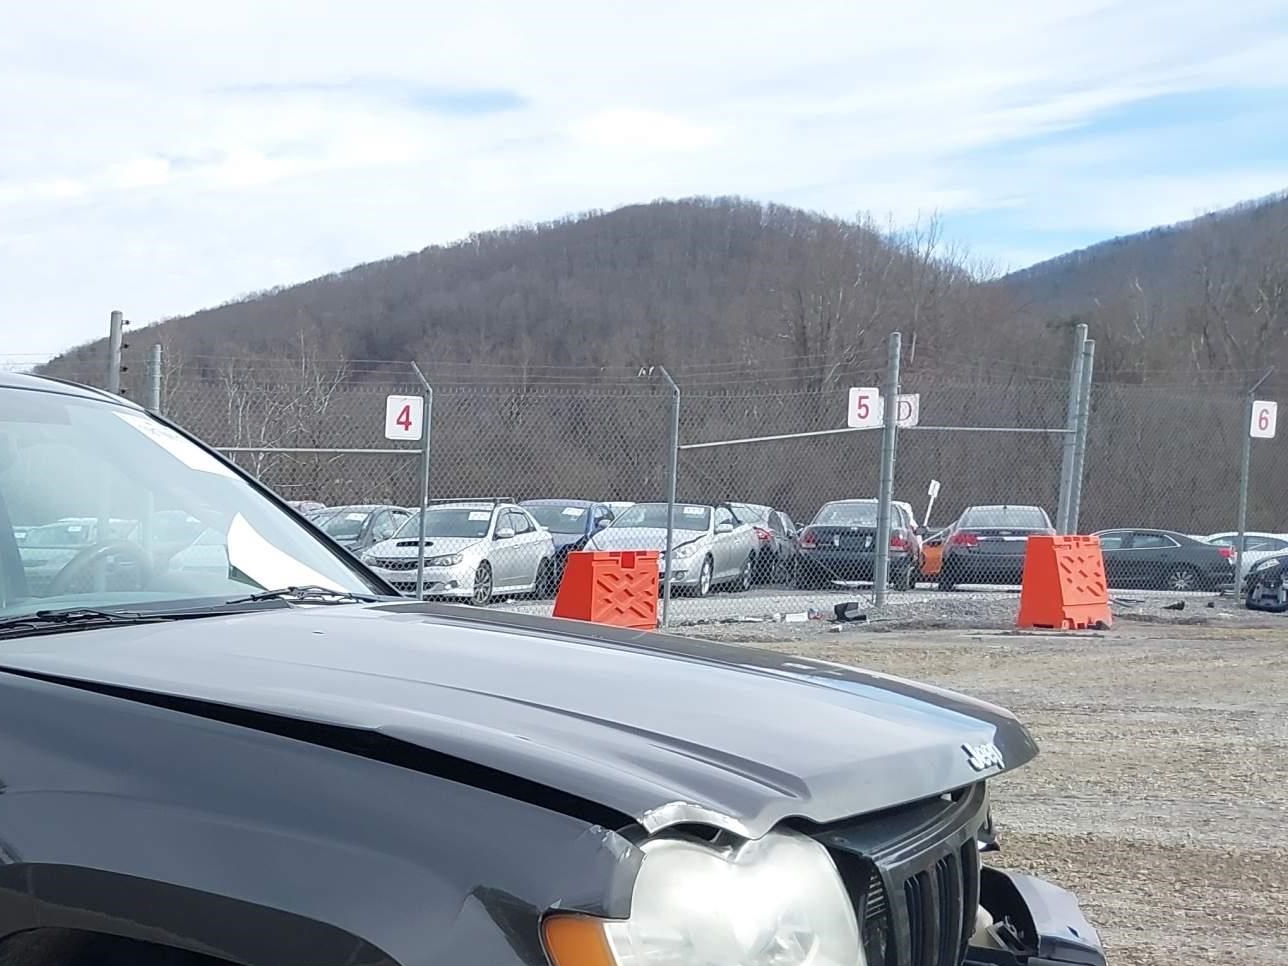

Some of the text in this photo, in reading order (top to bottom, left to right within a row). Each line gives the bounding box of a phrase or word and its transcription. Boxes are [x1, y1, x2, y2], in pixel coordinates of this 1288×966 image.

[395, 404, 413, 432] 4
[857, 395, 870, 420] 5
[1258, 408, 1270, 431] 6
